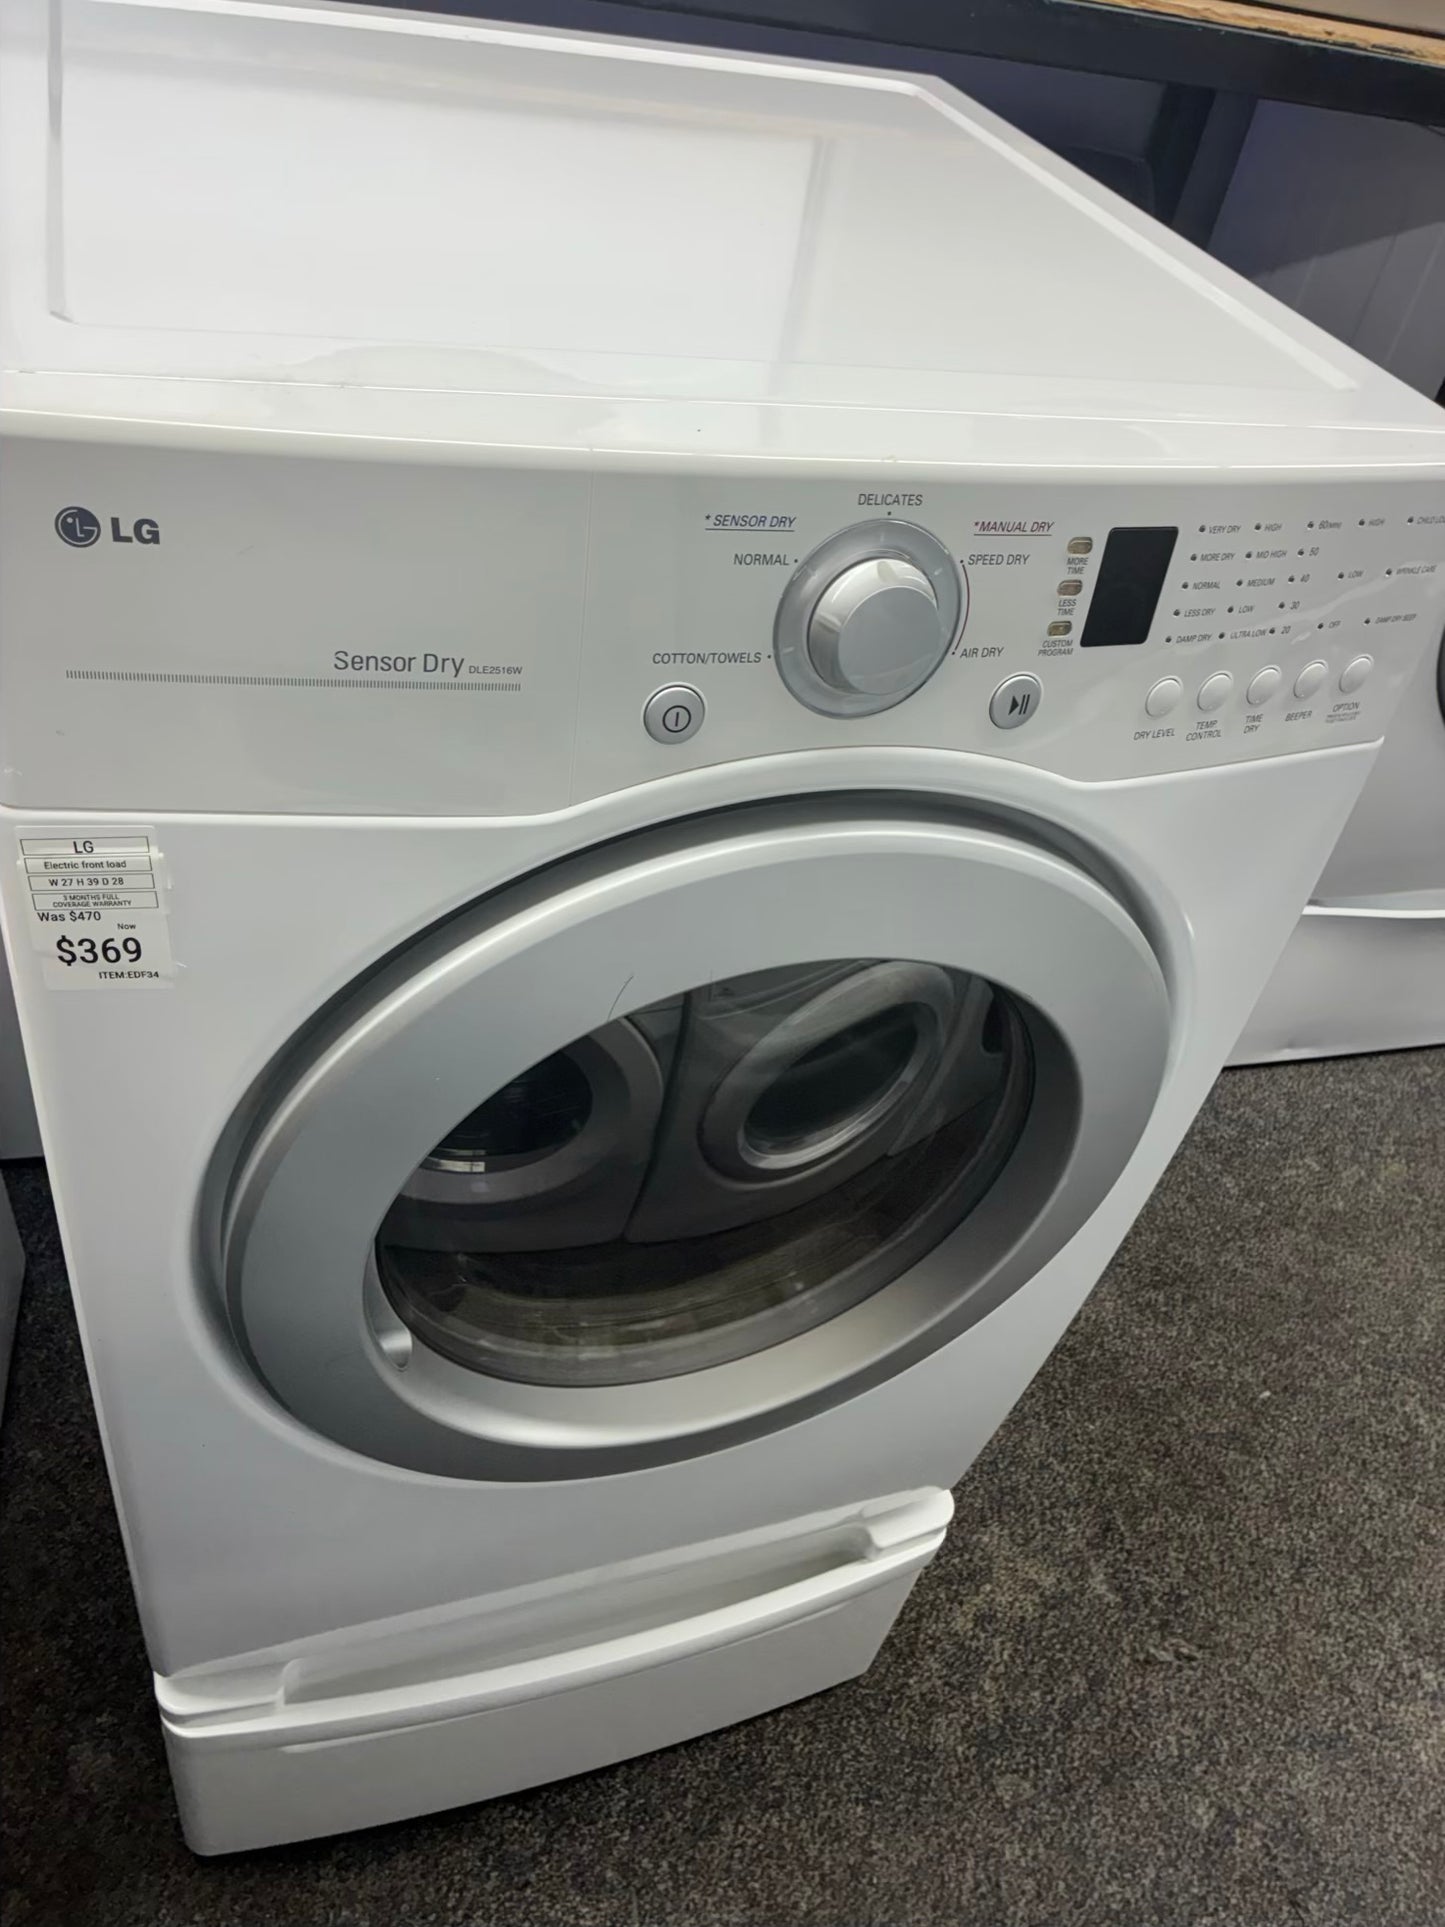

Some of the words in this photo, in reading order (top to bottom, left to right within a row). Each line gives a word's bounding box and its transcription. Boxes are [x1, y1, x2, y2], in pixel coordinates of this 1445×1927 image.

[857, 493, 923, 506] DELICATES
[769, 516, 796, 529] DRY
[1029, 521, 1054, 533] DRY
[1264, 523, 1282, 531] HIGH
[111, 516, 160, 545] LG
[1209, 525, 1227, 534] VERY
[1226, 525, 1241, 533] DRY
[1269, 550, 1287, 558] HIGH
[1309, 546, 1320, 556] 50
[733, 554, 789, 566] NORMAL
[968, 554, 1004, 566] SPEED
[1004, 554, 1030, 566] DRY
[1066, 557, 1088, 565] MORE
[1200, 553, 1220, 561] MORE
[1220, 553, 1235, 561] DRY
[1067, 566, 1085, 575] TIME
[1347, 570, 1364, 579] LOW
[1246, 578, 1275, 587] MEDIUM
[1300, 574, 1310, 583] 40
[1192, 582, 1220, 590] NORMAL
[1058, 599, 1076, 607] LESS
[1290, 601, 1300, 610] 30
[1057, 607, 1075, 616] TIME
[1184, 609, 1201, 617] LESS
[1201, 608, 1216, 617] DRY
[1238, 605, 1254, 614] LOW
[1229, 630, 1251, 640] ULTRA
[1251, 628, 1267, 637] LOW
[1281, 626, 1291, 635] 20
[1175, 635, 1198, 644] DAMP
[1197, 633, 1213, 642] DRY
[1042, 640, 1073, 649] CUSTOM
[960, 648, 979, 659] AIR
[979, 647, 1004, 659] DRY
[1037, 648, 1074, 657] PROGRAM
[652, 652, 762, 665] COTTON/TOWELS
[334, 650, 416, 673] Sensor
[422, 653, 465, 678] Dry
[468, 665, 523, 675] DLE2516W
[1332, 701, 1361, 713] OPTION
[1245, 714, 1264, 724] TIME
[1285, 710, 1313, 722] BEEPER
[1196, 720, 1218, 730] TEMP
[1243, 724, 1261, 734] DRY
[1133, 730, 1151, 740] DRY
[1151, 728, 1176, 738] LEVEL
[1185, 730, 1222, 742] CONTROL
[73, 840, 94, 854] LG
[44, 860, 79, 870] Electric
[81, 859, 104, 869] front
[106, 860, 127, 869] load
[49, 879, 59, 887] W
[61, 879, 74, 887] 27
[76, 878, 85, 886] H
[86, 878, 99, 886] 39
[102, 878, 109, 886] D
[112, 877, 125, 886] 28
[69, 893, 100, 901] MONTHS
[37, 911, 66, 922] Was
[69, 910, 101, 923] $470
[117, 922, 136, 930] Now
[56, 934, 142, 967] $369
[98, 970, 160, 979] ITEM:EDF34
